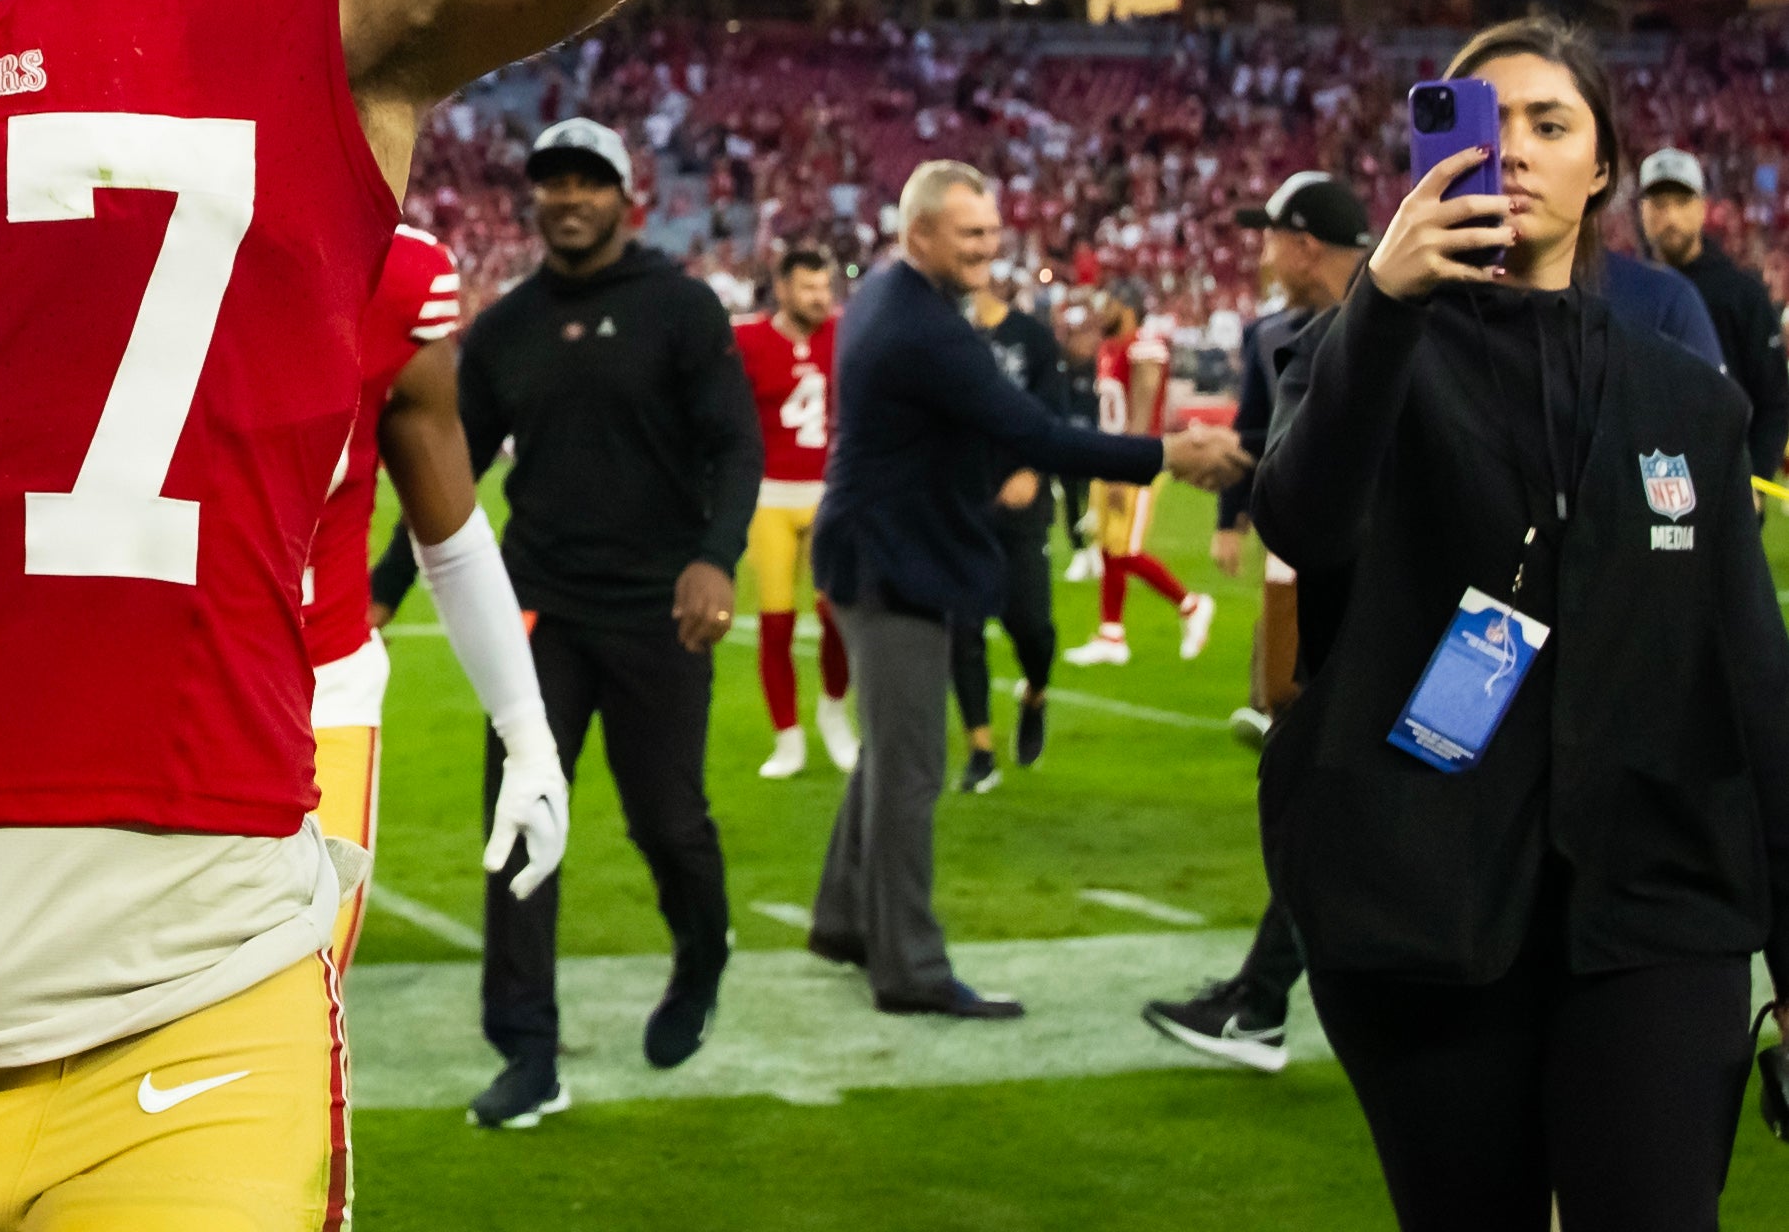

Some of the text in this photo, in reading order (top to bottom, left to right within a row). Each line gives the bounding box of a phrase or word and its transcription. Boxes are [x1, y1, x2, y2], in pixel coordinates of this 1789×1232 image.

[779, 372, 828, 450] 4
[1650, 479, 1690, 507] NFL
[1650, 525, 1695, 551] MEDIA
